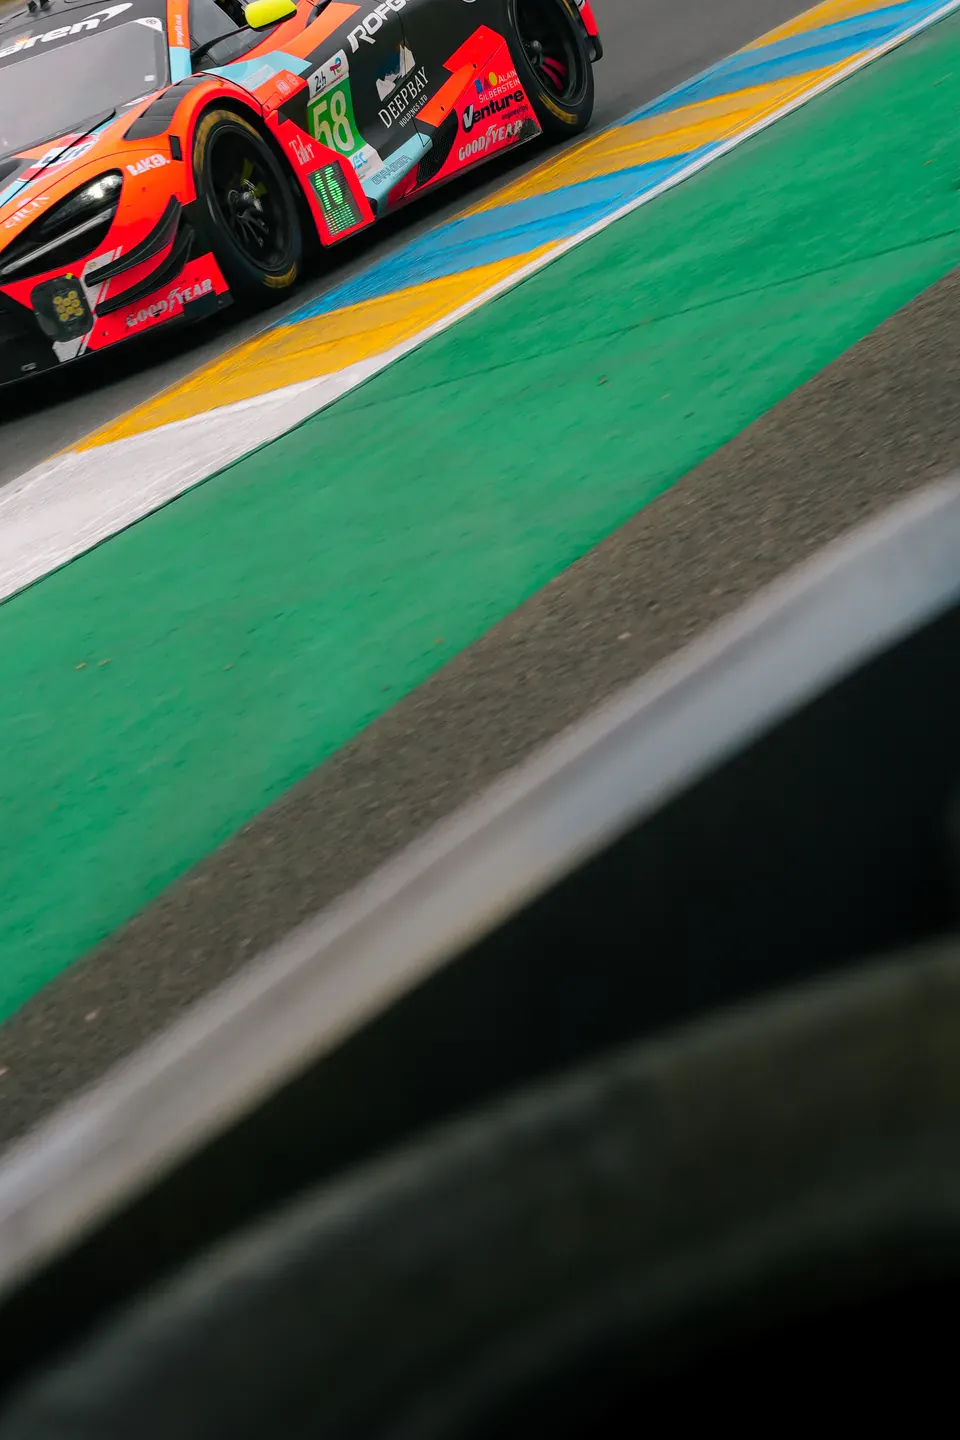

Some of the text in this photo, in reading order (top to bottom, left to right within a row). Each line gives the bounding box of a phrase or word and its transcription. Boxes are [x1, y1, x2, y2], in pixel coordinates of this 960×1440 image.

[378, 66, 429, 129] DEEPBAY
[478, 78, 521, 104] SILBERSTEIN
[498, 69, 518, 83] ALAIN
[312, 90, 355, 152] 58
[398, 94, 429, 128] HOLDINGS LTD
[462, 89, 525, 133] Venture
[125, 277, 214, 328] GOODYEAR
